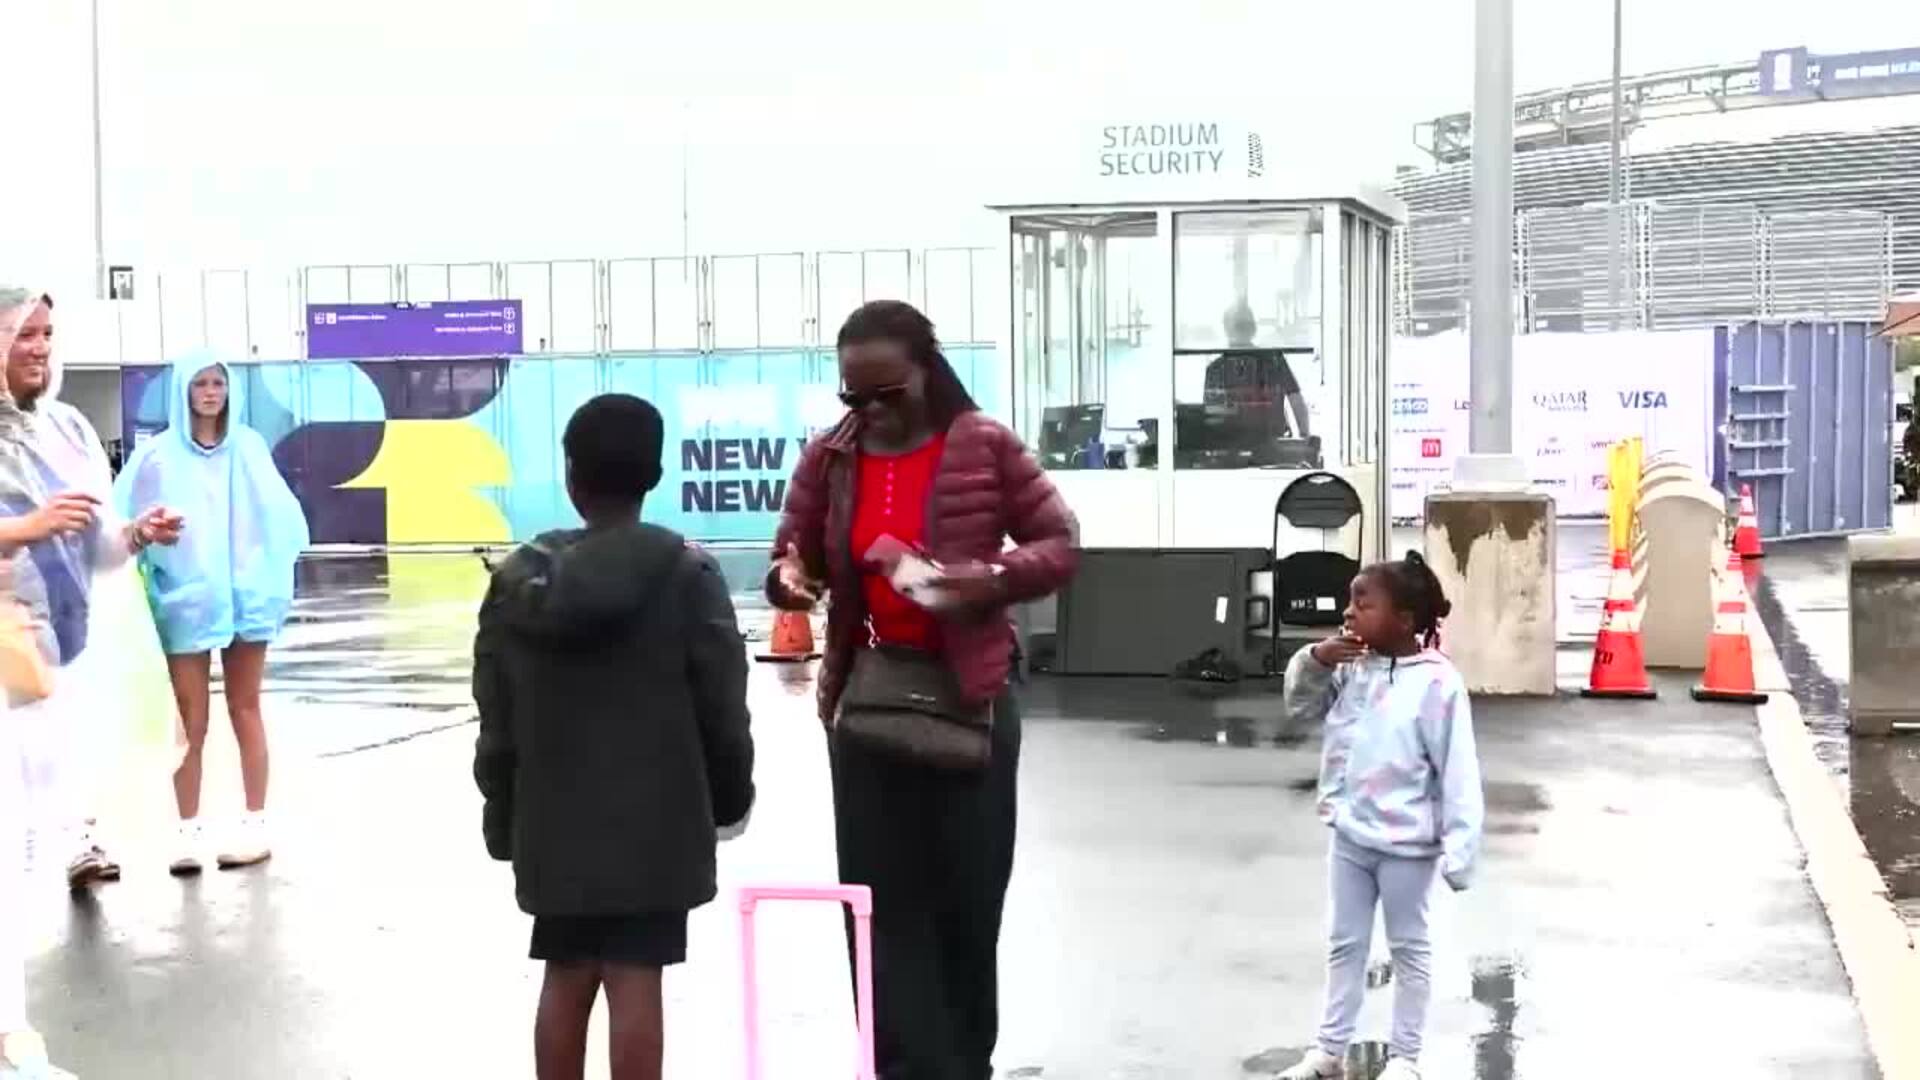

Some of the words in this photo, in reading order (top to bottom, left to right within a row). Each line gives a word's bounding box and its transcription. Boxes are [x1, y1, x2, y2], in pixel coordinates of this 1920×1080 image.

[1103, 123, 1219, 149] STADIUM
[1100, 149, 1224, 177] SECURITY
[1618, 390, 1669, 409] VISA
[681, 437, 786, 472] NEW
[681, 479, 786, 513] NEW
